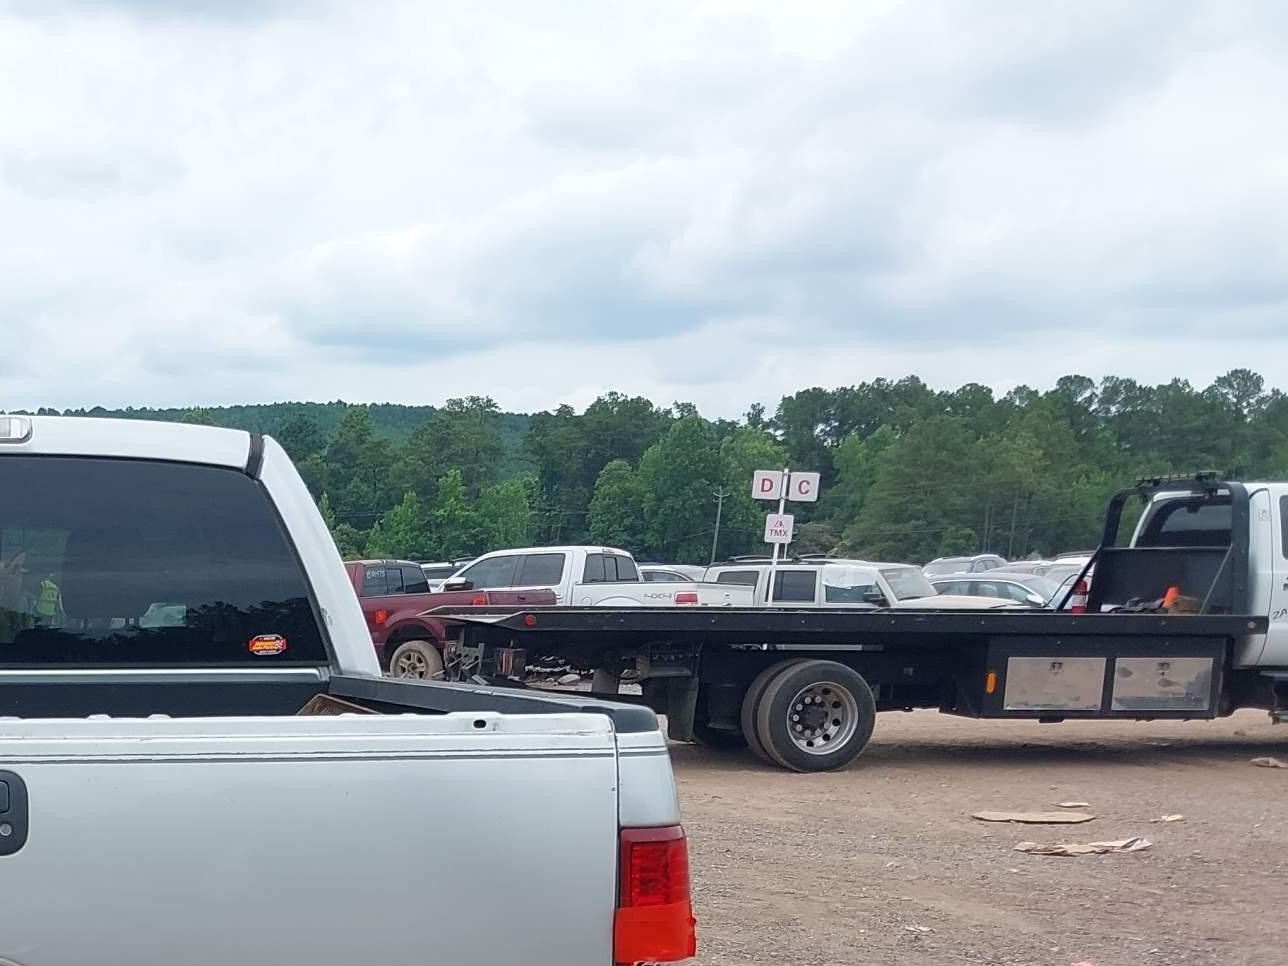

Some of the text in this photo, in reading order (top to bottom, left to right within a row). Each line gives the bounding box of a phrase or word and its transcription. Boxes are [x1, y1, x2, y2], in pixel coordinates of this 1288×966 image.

[760, 478, 774, 493] D
[798, 479, 811, 495] C
[769, 529, 789, 537] TMX
